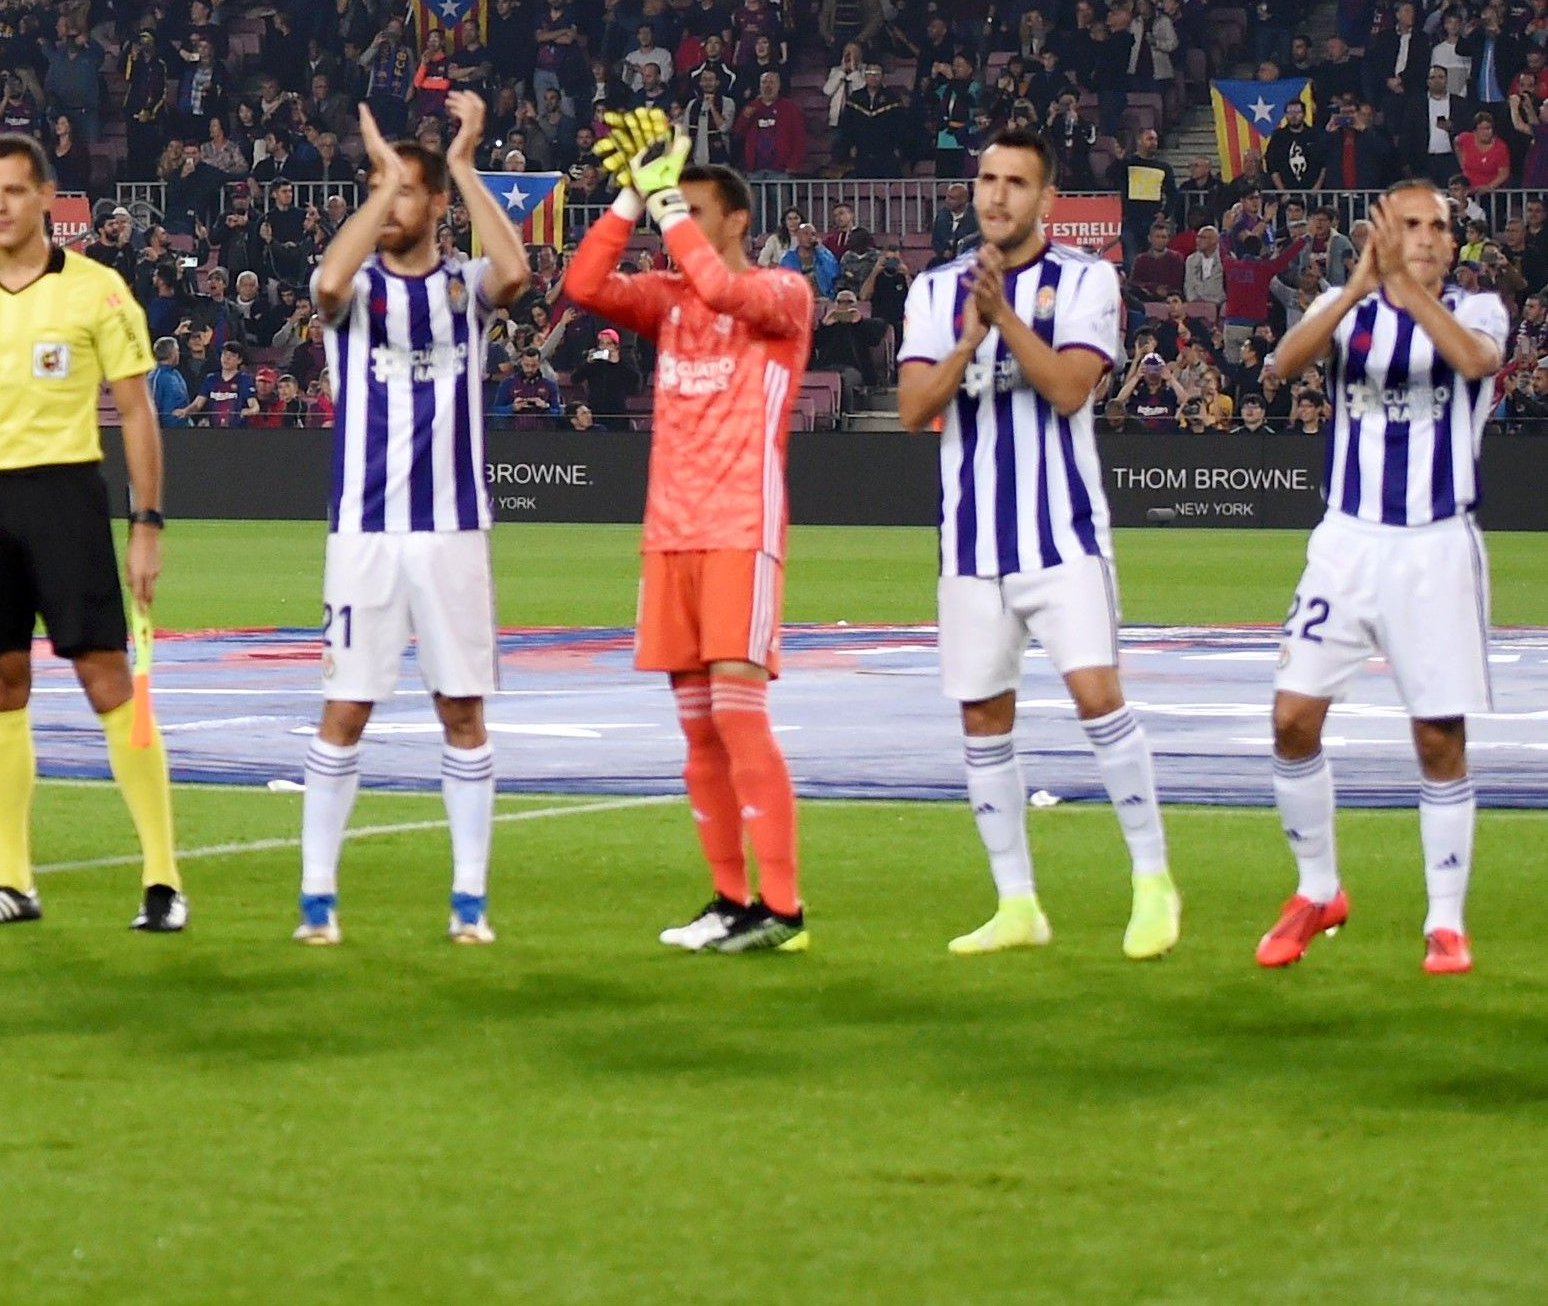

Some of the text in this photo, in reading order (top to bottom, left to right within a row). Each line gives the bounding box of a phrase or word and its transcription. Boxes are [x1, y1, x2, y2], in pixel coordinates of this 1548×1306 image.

[53, 222, 88, 236] ELLA
[1112, 468, 1315, 490] THOM BROWNE.
[498, 497, 536, 509] YORK
[1174, 503, 1254, 516] NEW YORK
